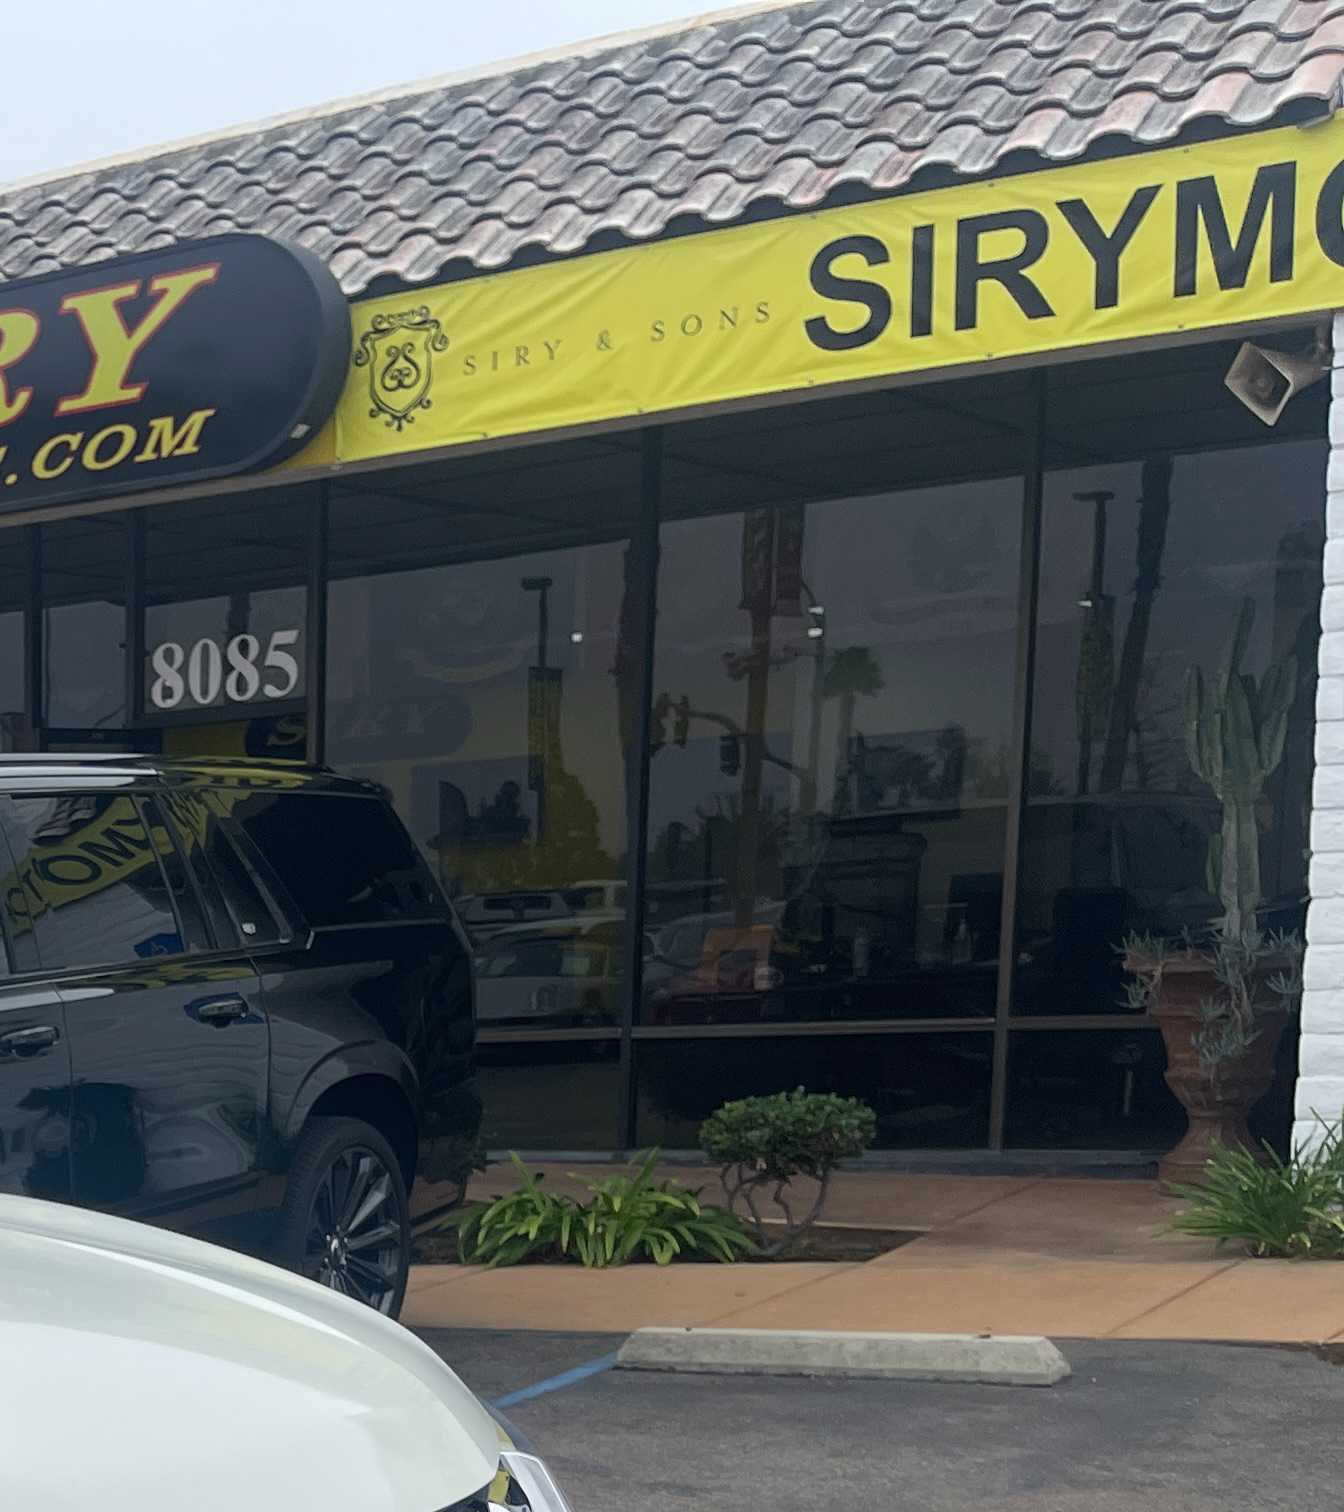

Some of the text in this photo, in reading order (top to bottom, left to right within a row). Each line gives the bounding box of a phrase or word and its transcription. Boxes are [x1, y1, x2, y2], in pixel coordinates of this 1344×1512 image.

[803, 160, 1344, 352] SIRYM
[462, 301, 771, 376] SIRY & SONS
[151, 629, 299, 708] 8085
